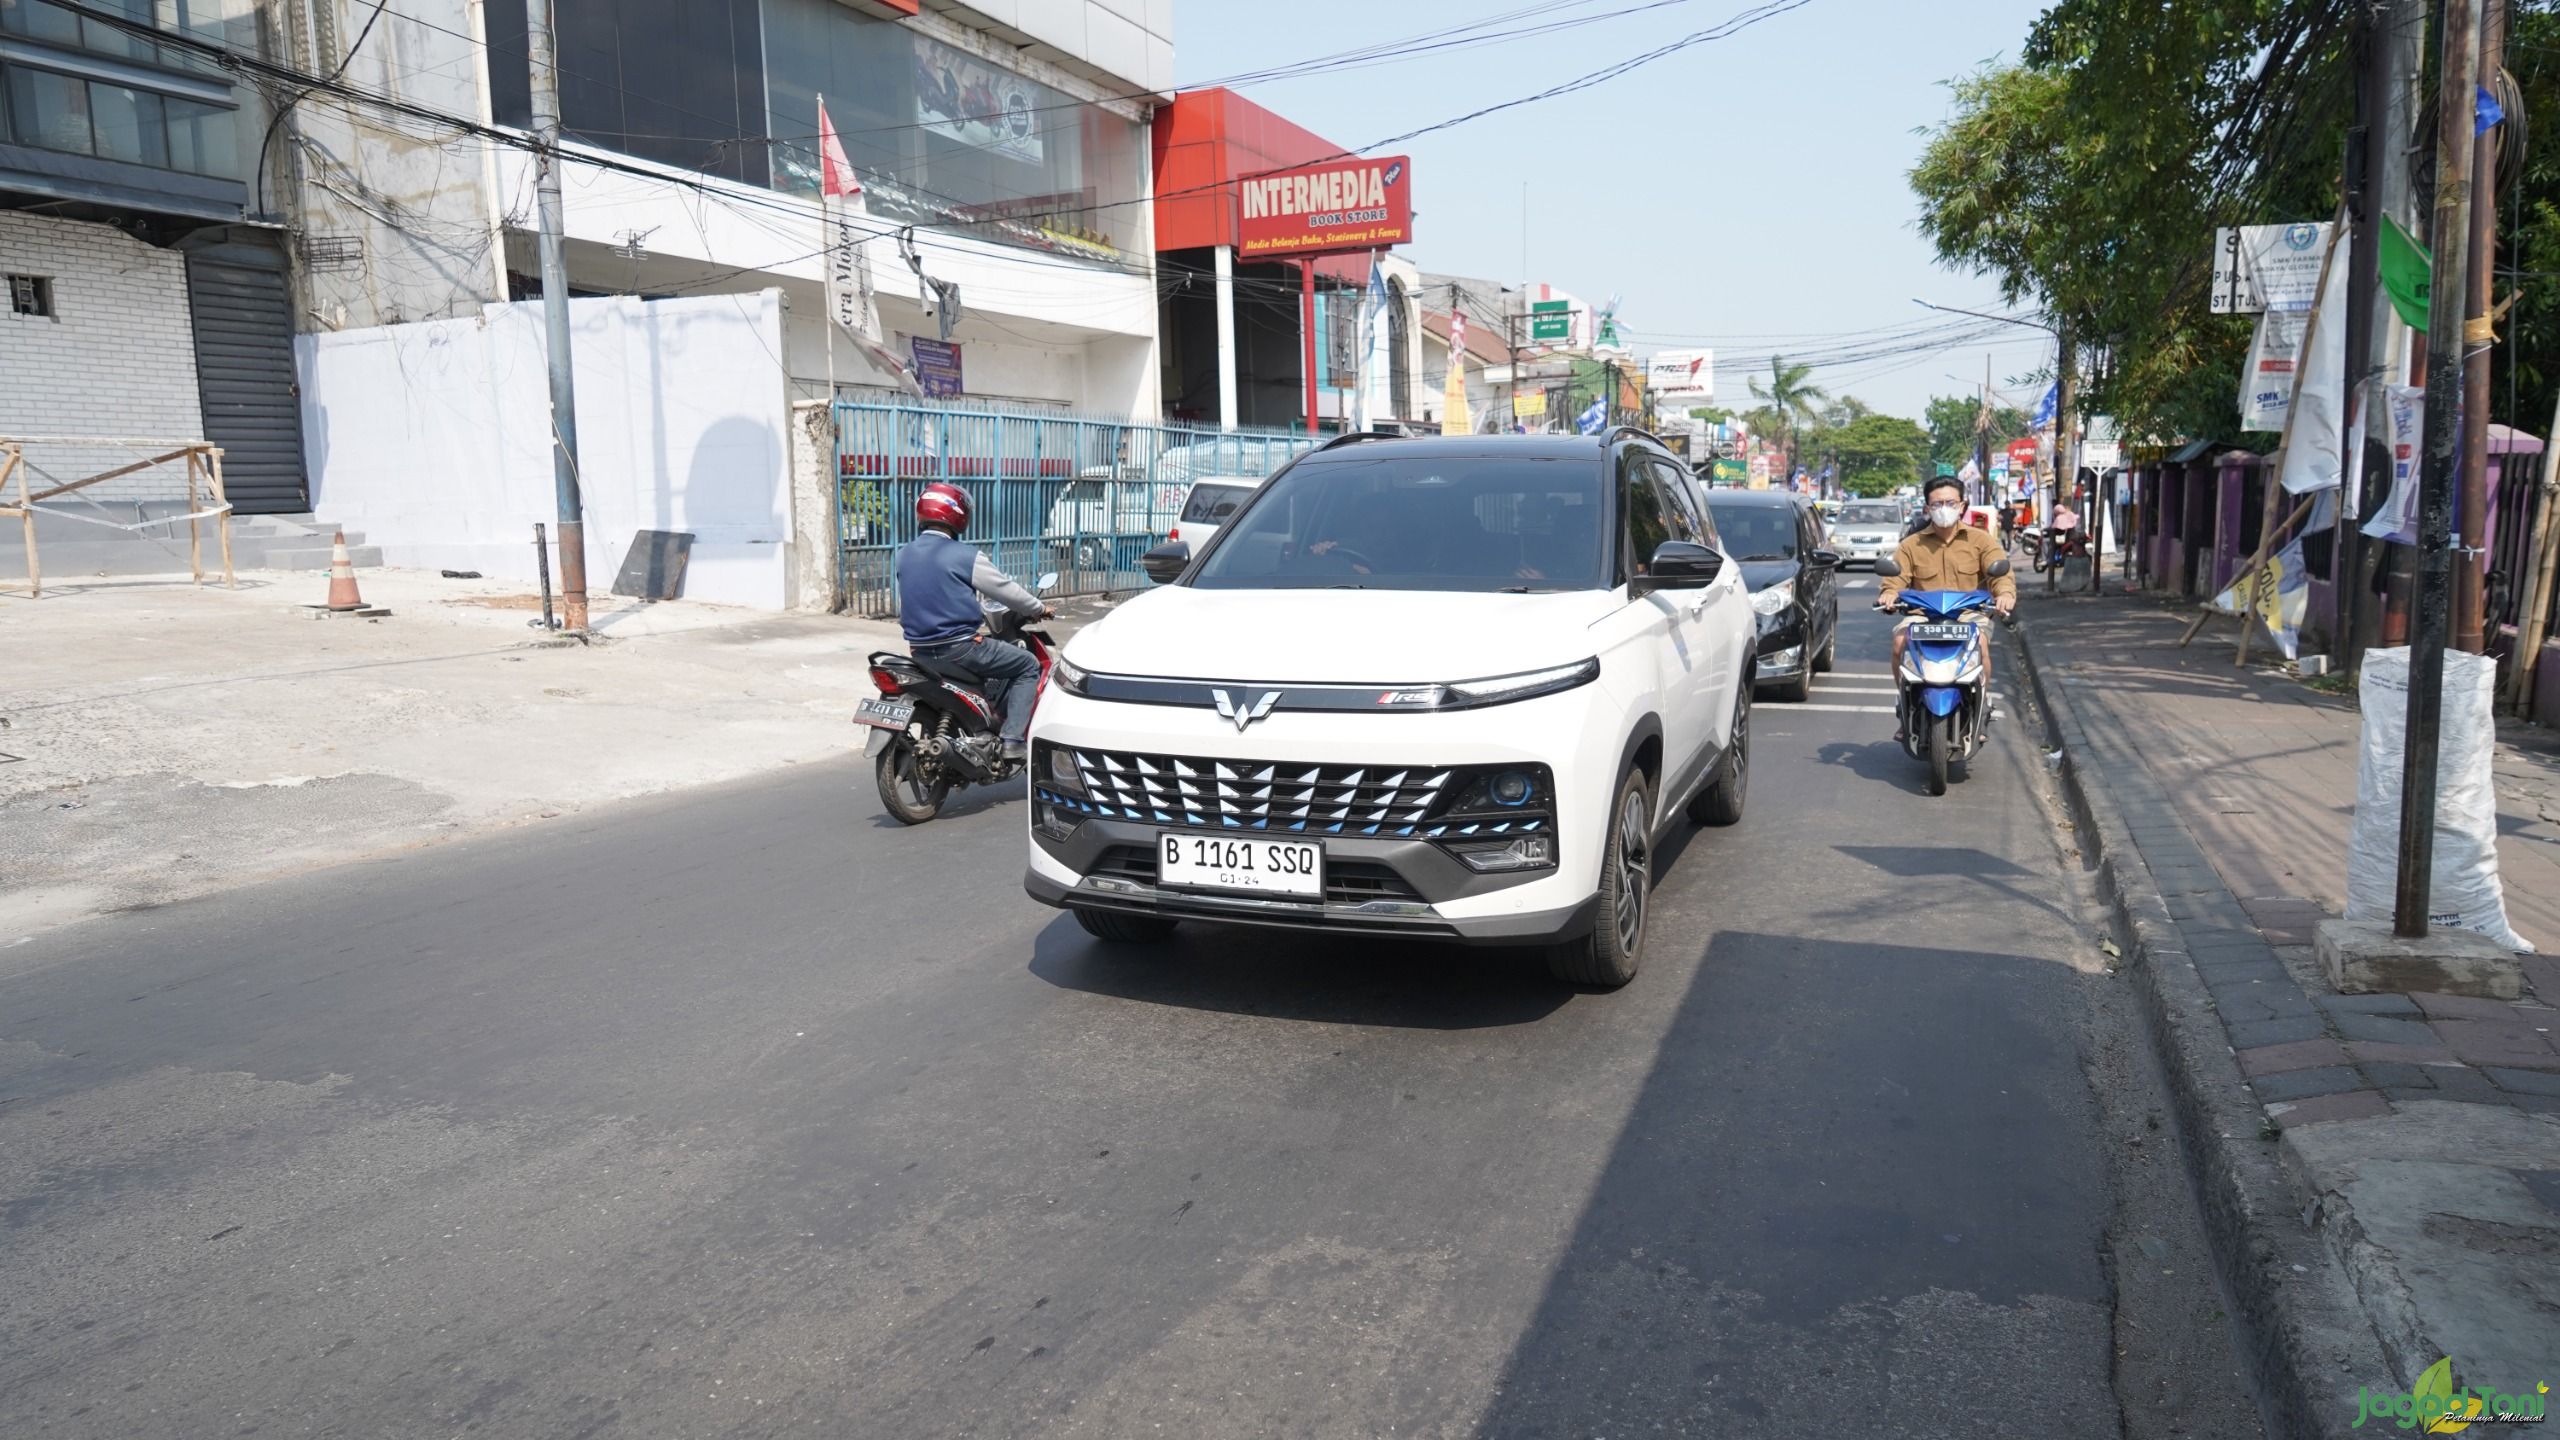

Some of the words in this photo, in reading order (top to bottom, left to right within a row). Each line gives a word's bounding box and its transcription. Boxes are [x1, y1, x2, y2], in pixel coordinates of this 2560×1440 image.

[1243, 167, 1386, 219] INTERMEDIA
[1309, 214, 1343, 227] BOOK
[1347, 209, 1387, 223] STORE
[1246, 239, 1269, 250] Media
[1271, 237, 1300, 248] Belanja
[1326, 231, 1368, 242] Stationery
[1369, 229, 1376, 238] &
[1378, 228, 1402, 239] Fancy
[836, 220, 852, 286] Motor
[2212, 295, 2257, 308] STTUS
[2256, 391, 2280, 404] SMK
[1166, 838, 1180, 864] B
[1195, 839, 1254, 870] 1161
[1267, 845, 1313, 875] SSQ
